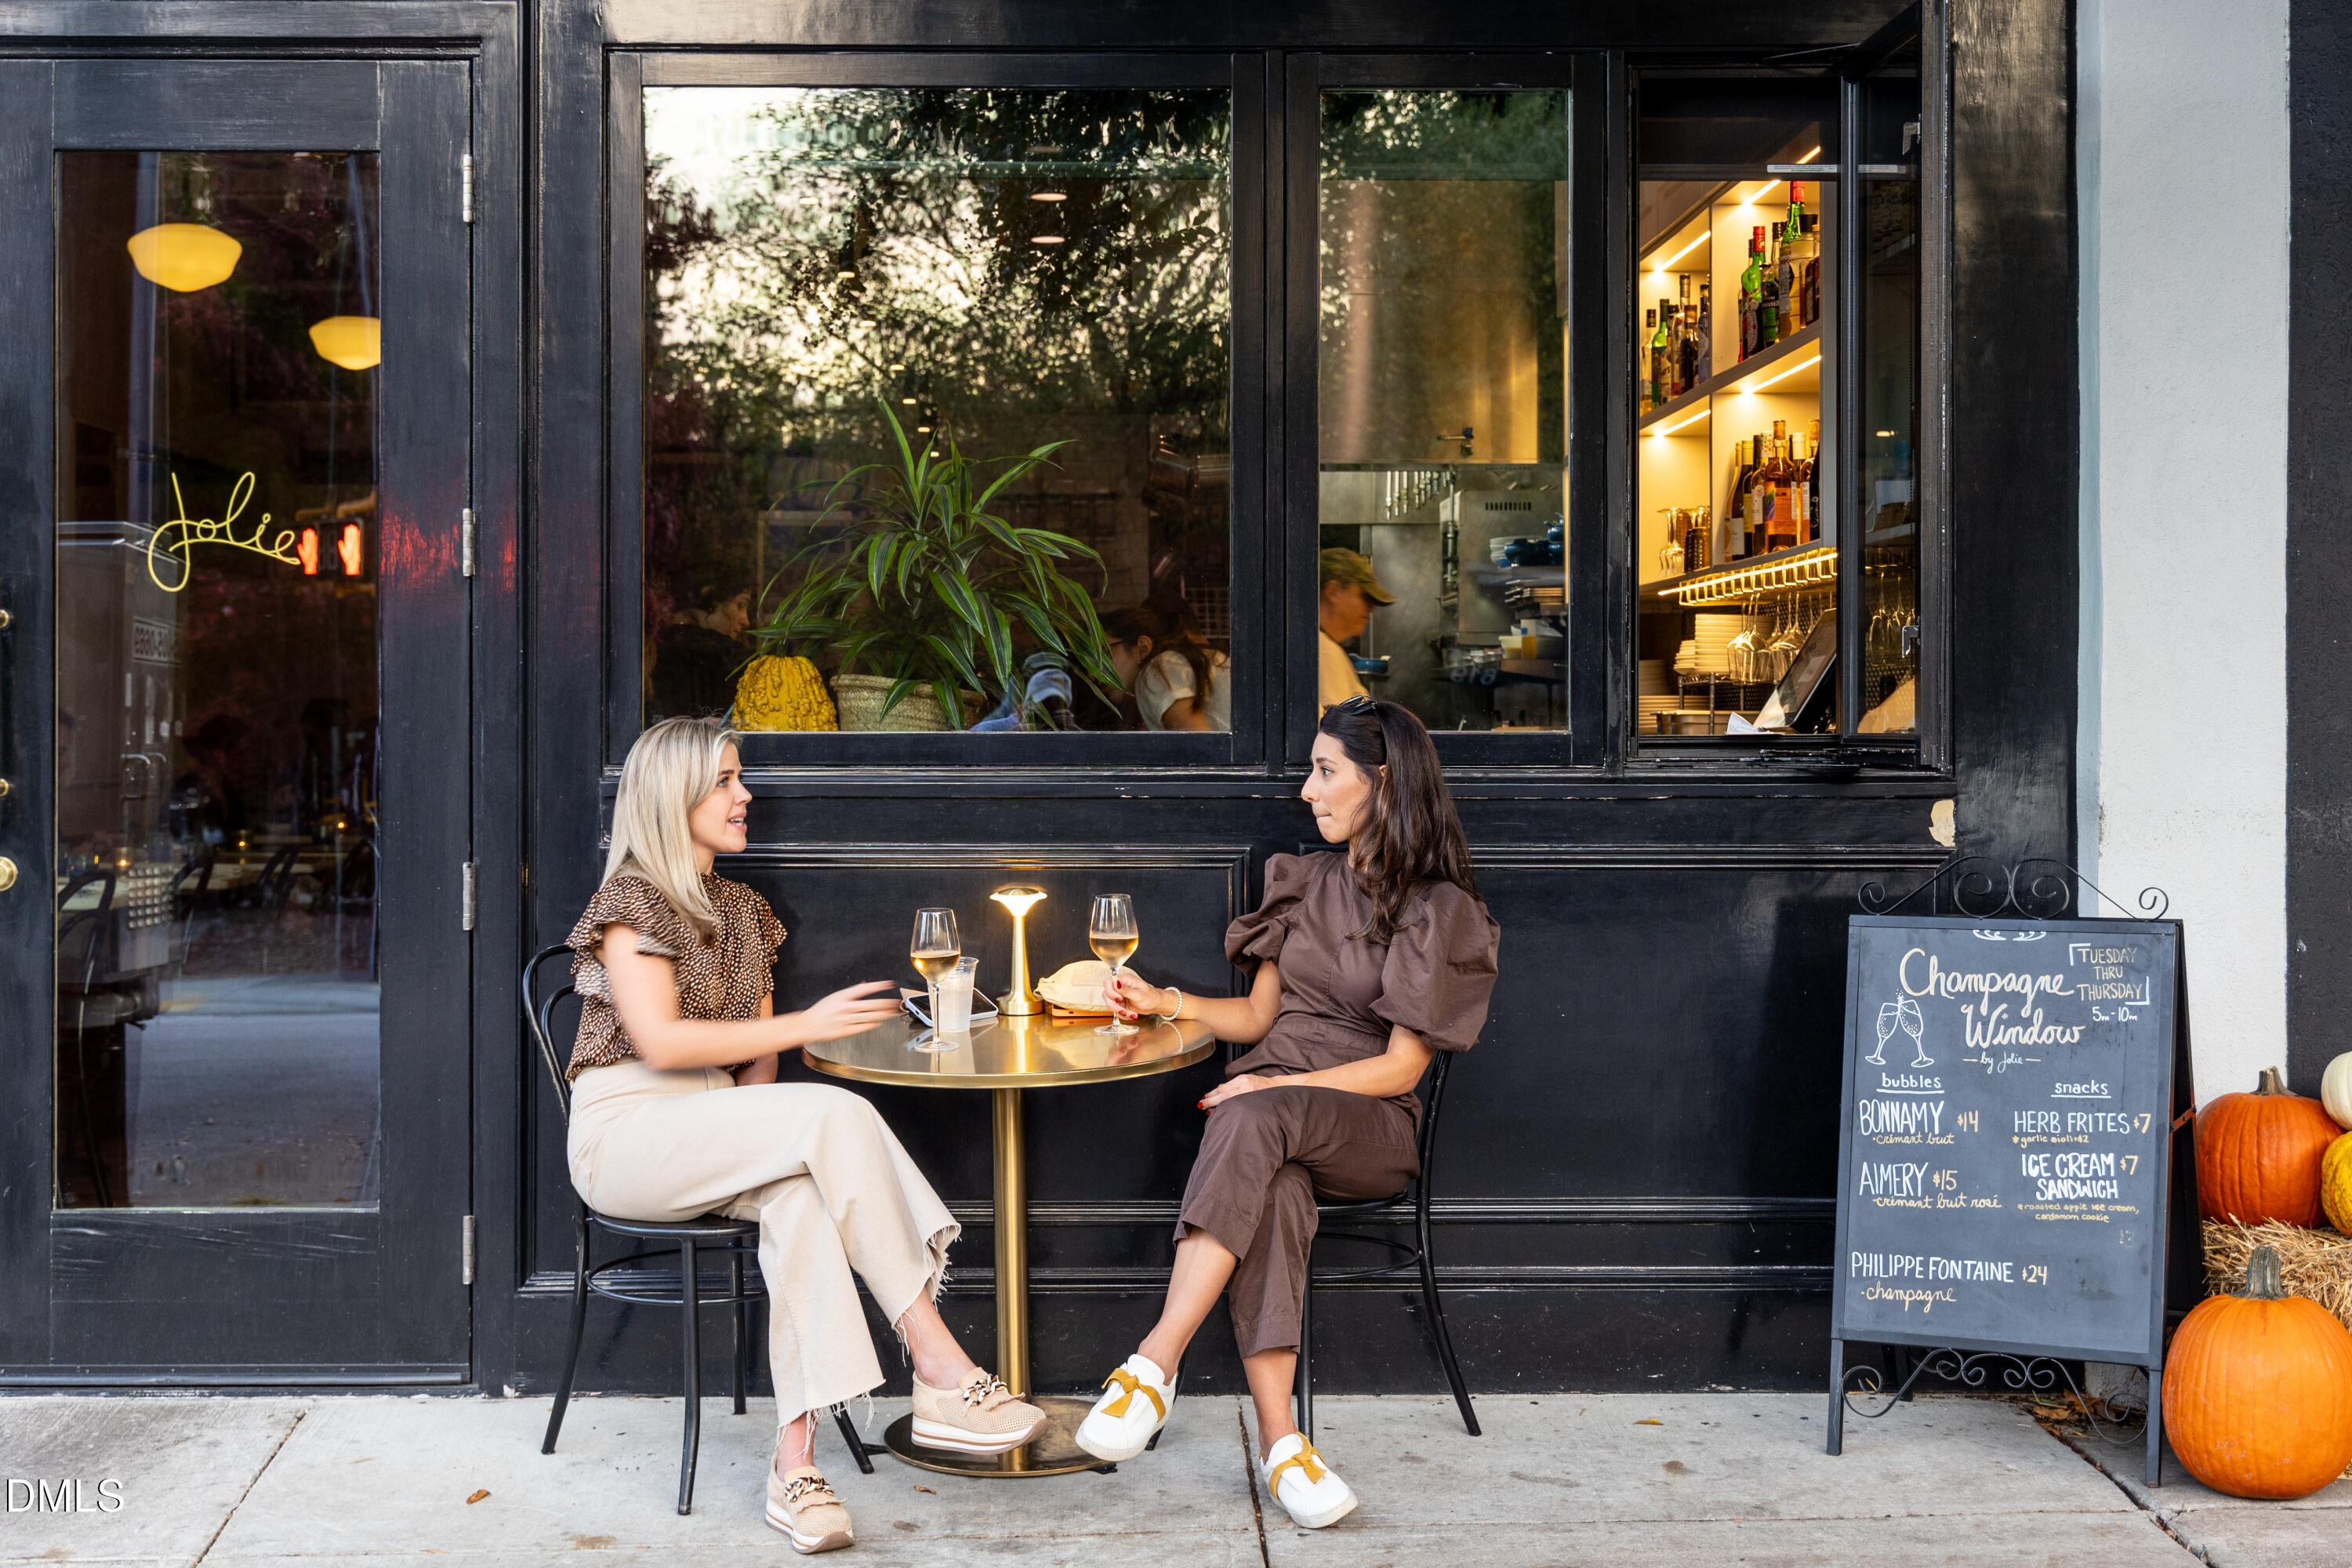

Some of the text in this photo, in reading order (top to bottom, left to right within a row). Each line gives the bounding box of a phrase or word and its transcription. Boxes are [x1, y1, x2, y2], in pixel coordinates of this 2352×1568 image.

[2077, 946, 2138, 964] TUESDAY
[1900, 948, 2075, 1018] Champagne
[2093, 965, 2124, 980] THRU
[2076, 982, 2143, 1001] THURSDAY
[1961, 1004, 2086, 1049] Window
[1980, 1051, 2024, 1074] by Jolie
[1882, 1072, 1942, 1088] bubbles
[2054, 1079, 2109, 1094] snacks
[1859, 1099, 1979, 1135] BONNAMY $14
[2014, 1110, 2151, 1134] HERB FRITES $7
[1926, 1131, 1955, 1145] brut
[2020, 1134, 2049, 1149] garlic
[2021, 1152, 2139, 1178] ICE CREAM $7
[1859, 1161, 1958, 1198] AIMERY $15
[2035, 1178, 2119, 1201] SANDWICH
[1936, 1192, 1968, 1209] brut
[1970, 1194, 2003, 1208] rosé
[2081, 1213, 2111, 1223] cookie
[1851, 1251, 2048, 1286] PHILIPPE FONTAINE $24
[1866, 1280, 1957, 1314] champagne
